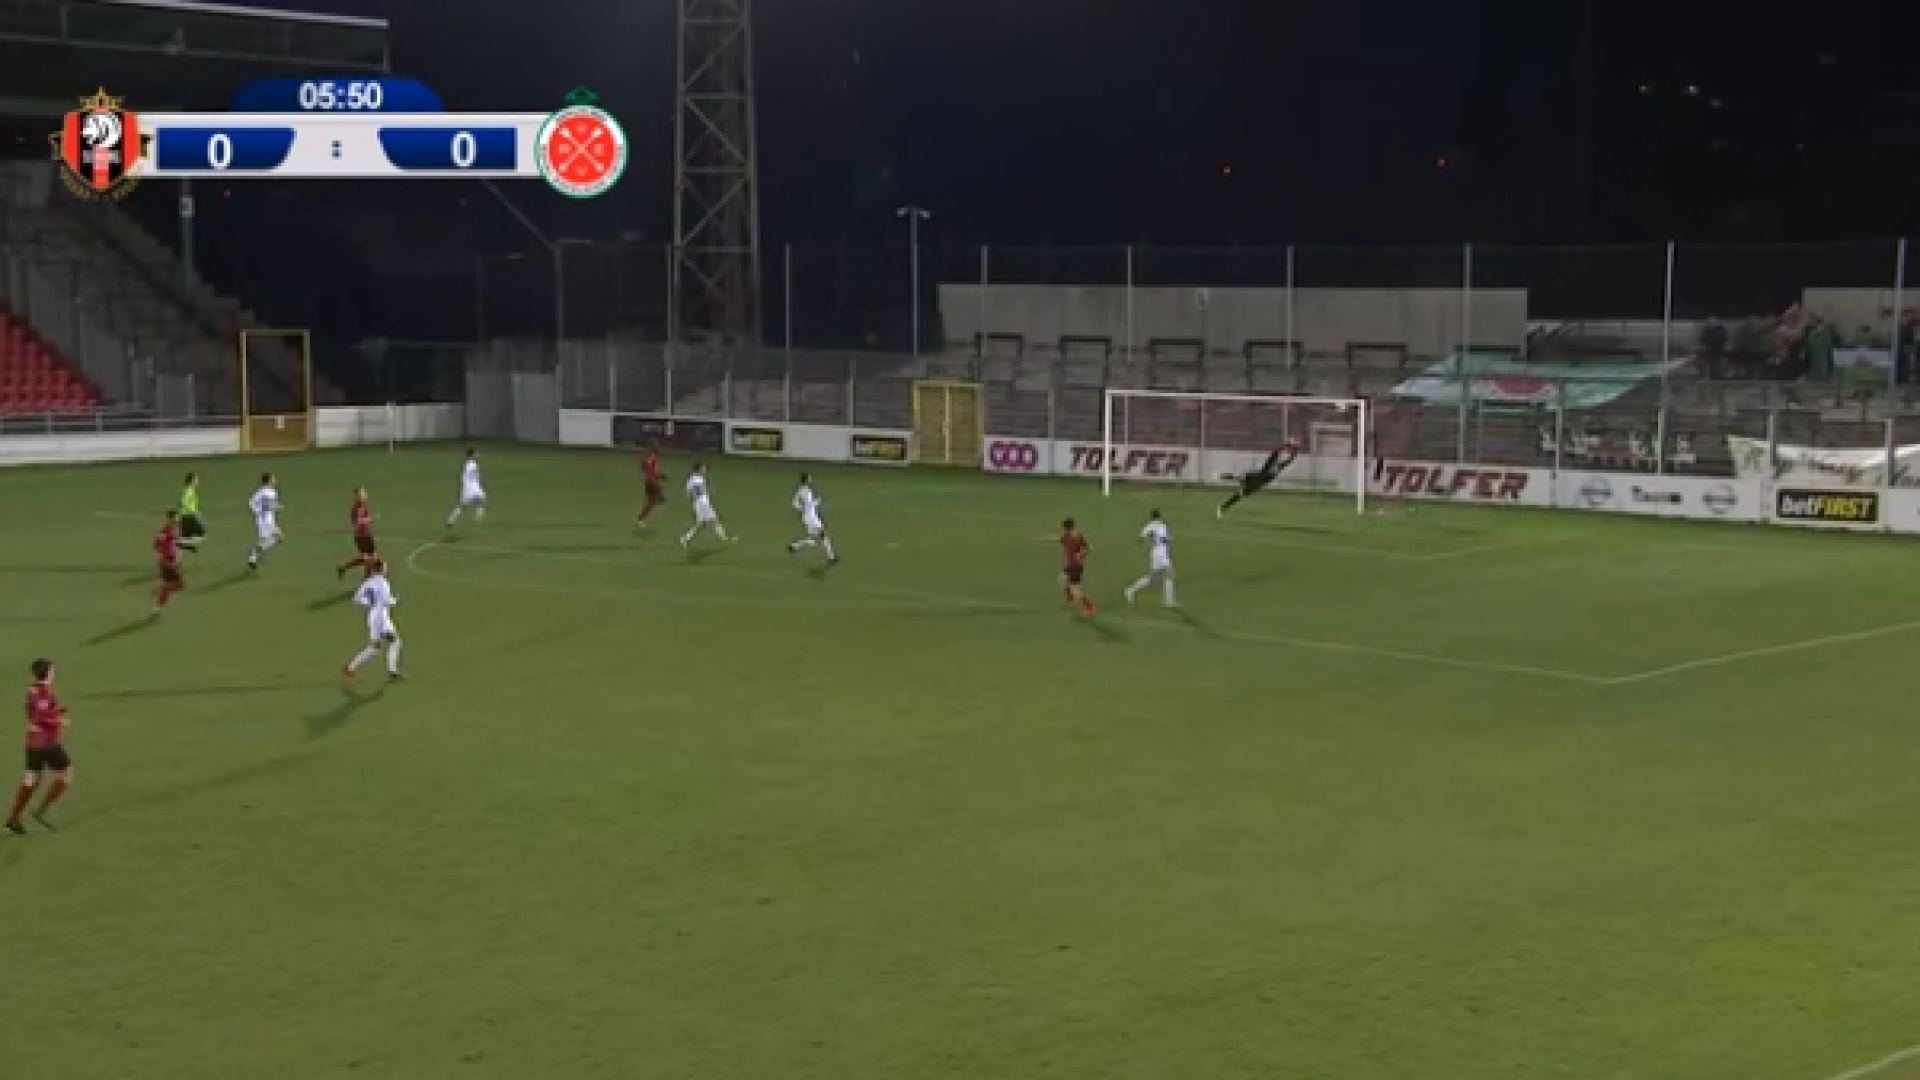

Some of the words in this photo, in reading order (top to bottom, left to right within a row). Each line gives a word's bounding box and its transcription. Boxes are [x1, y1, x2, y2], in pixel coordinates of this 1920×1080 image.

[1070, 446, 1189, 477] TOLFER
[1383, 465, 1530, 500] TOLFER
[1780, 494, 1874, 519] betFIRST
